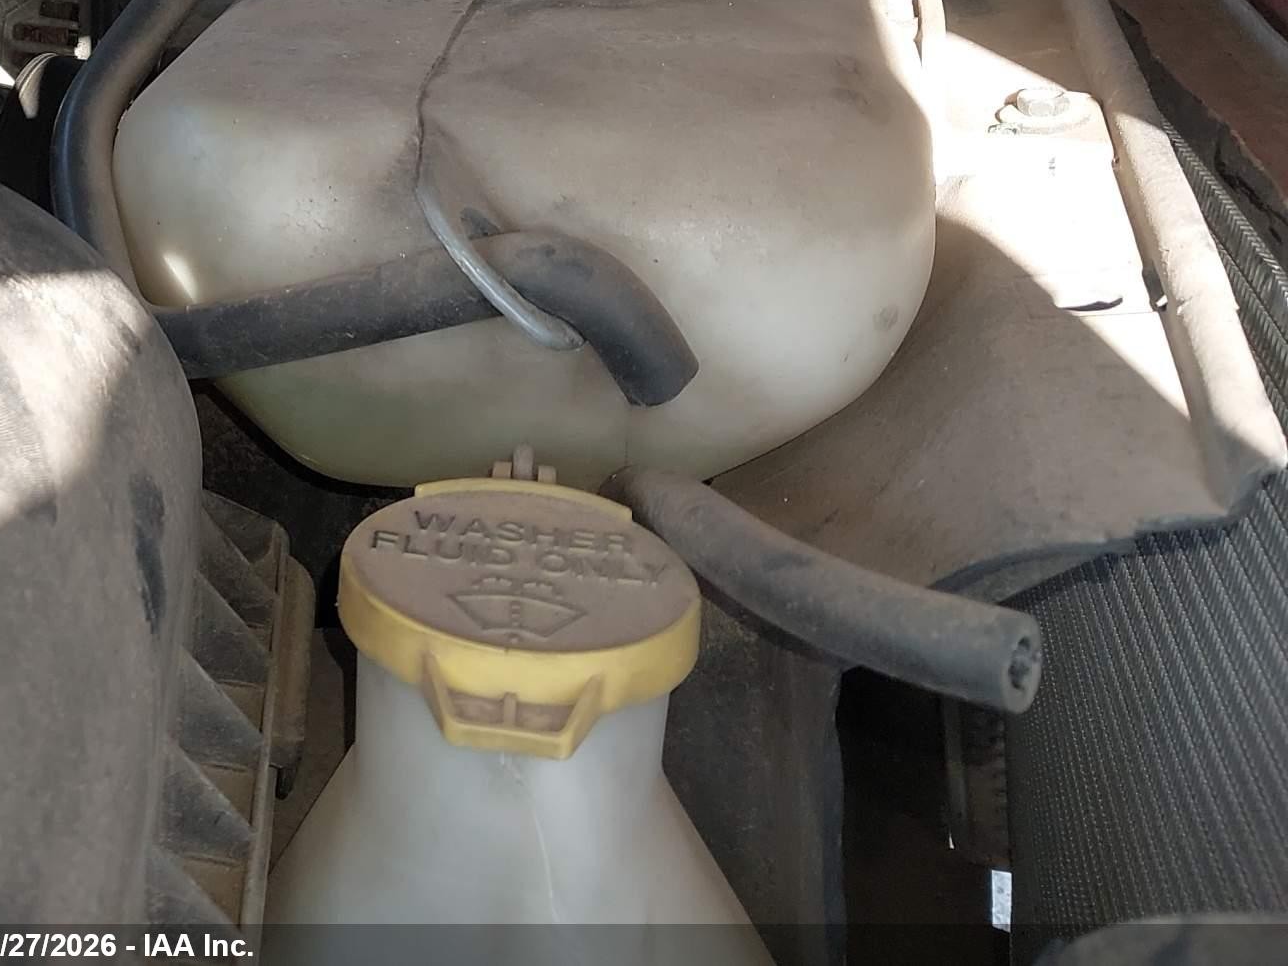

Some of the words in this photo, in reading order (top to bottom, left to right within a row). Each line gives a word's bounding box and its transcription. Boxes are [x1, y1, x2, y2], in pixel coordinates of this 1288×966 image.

[414, 509, 633, 555] WASHER
[371, 530, 517, 569] FLUID
[539, 549, 668, 588] ONLY
